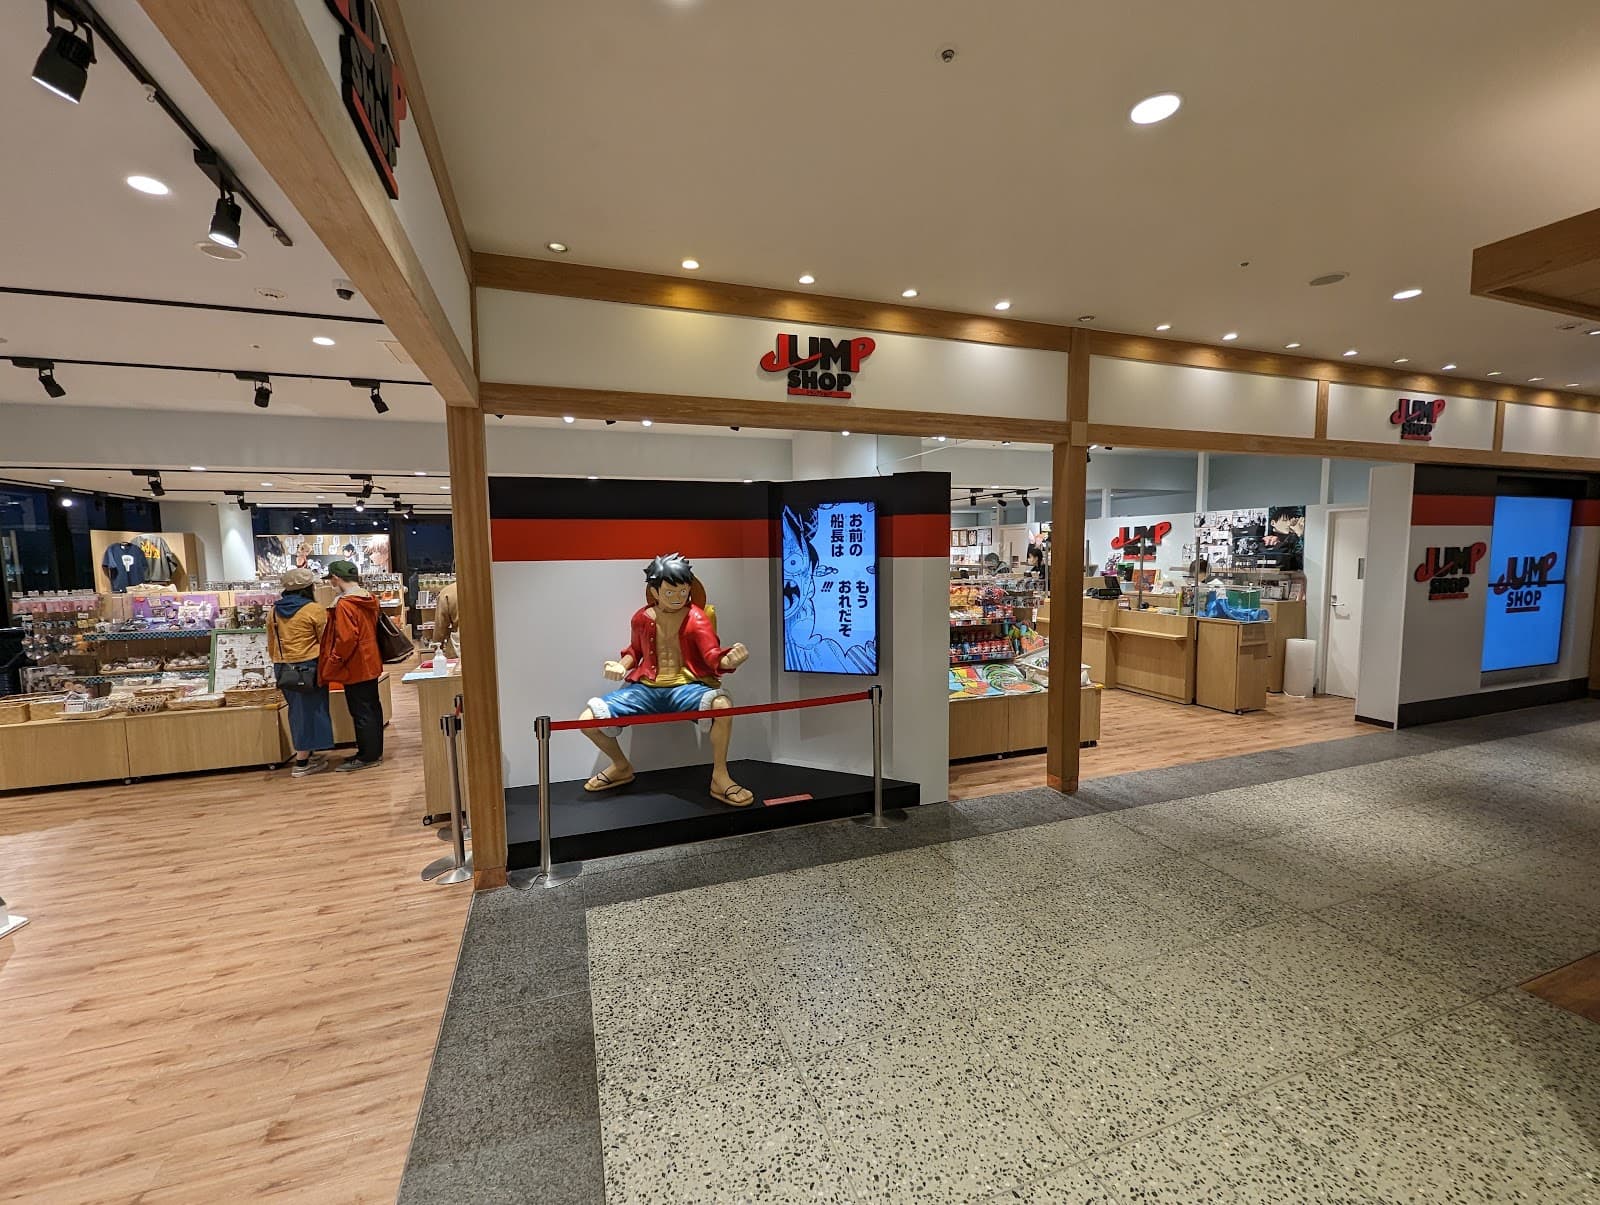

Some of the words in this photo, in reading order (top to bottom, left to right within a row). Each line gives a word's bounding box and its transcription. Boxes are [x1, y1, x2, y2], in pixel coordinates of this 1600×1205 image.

[760, 333, 876, 373] JUMP
[788, 369, 852, 391] SHOP
[1390, 398, 1446, 424] JUMP
[1401, 423, 1433, 436] SHOP
[830, 513, 845, 558] 船長は
[849, 513, 863, 557] お前の
[1111, 521, 1172, 550] JUMP
[1414, 542, 1487, 583] JUMP
[1493, 552, 1557, 595] JUMP
[855, 580, 870, 609] もう
[1429, 576, 1470, 594] SHOP
[1506, 590, 1542, 607] SHOP
